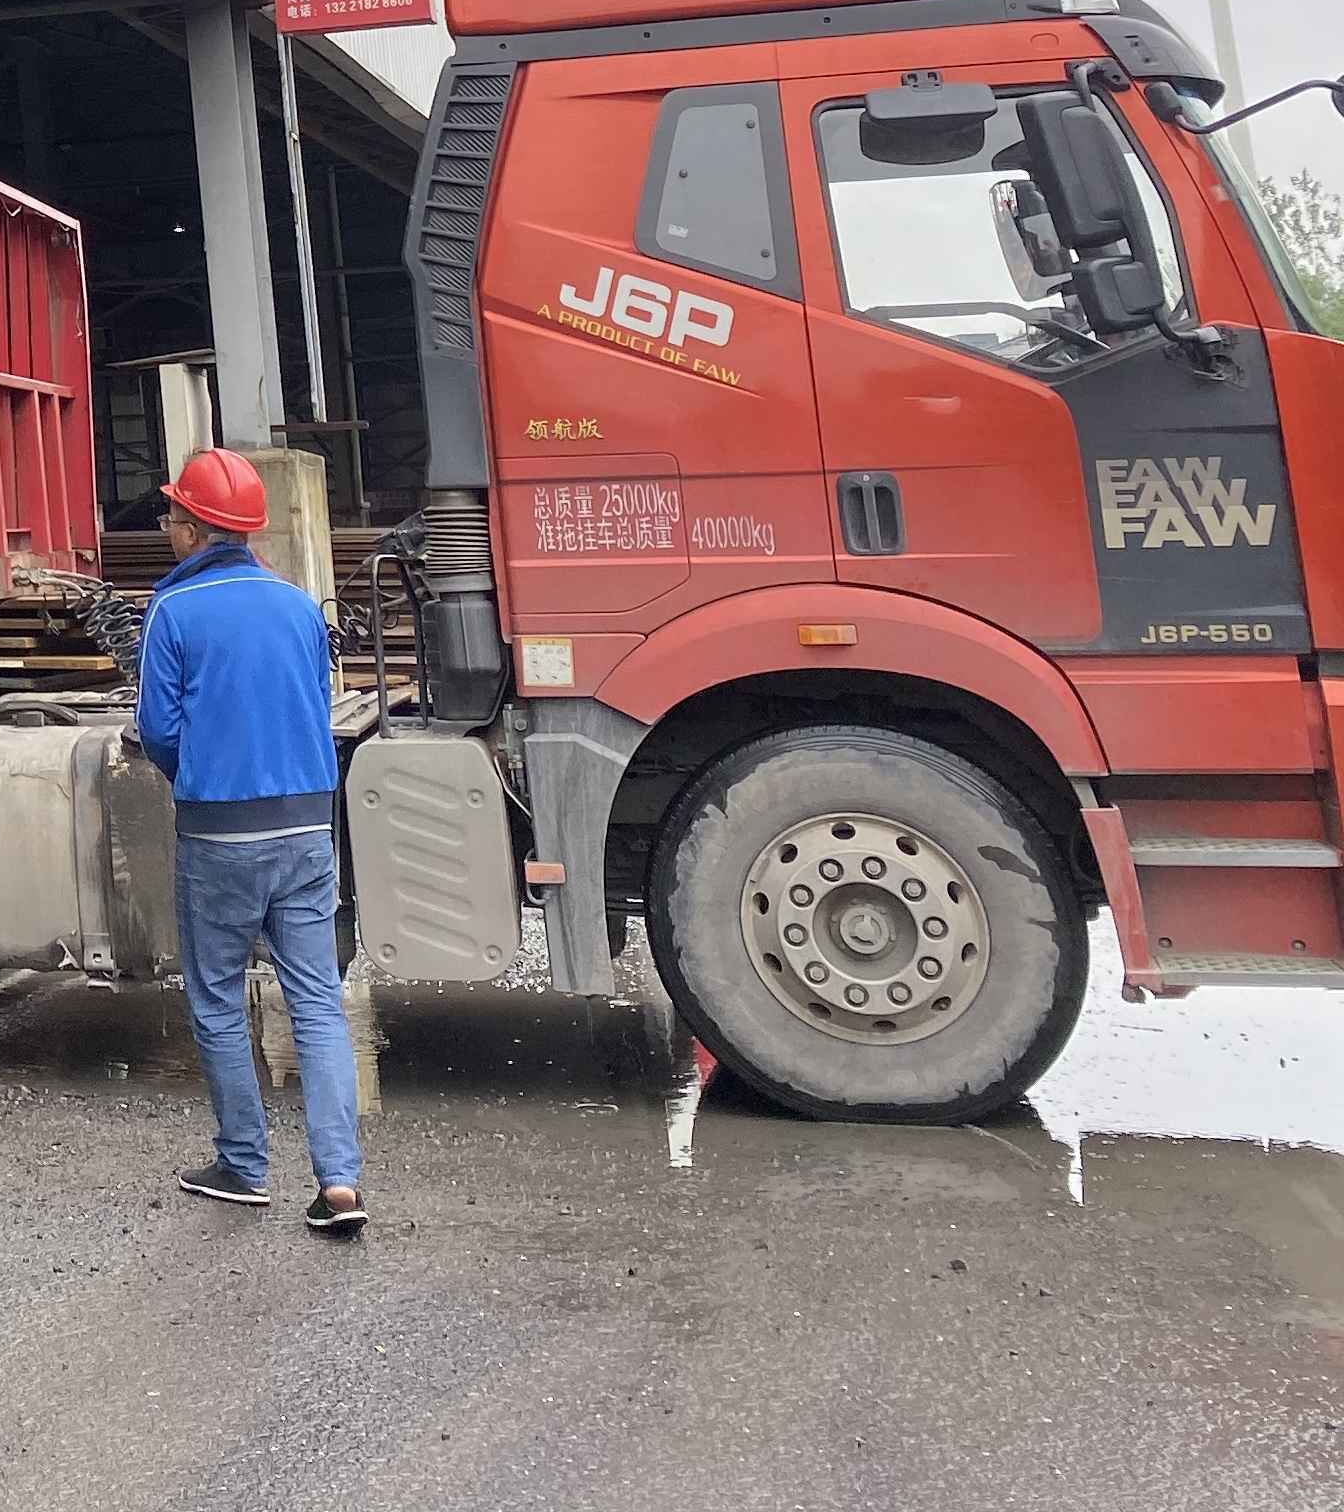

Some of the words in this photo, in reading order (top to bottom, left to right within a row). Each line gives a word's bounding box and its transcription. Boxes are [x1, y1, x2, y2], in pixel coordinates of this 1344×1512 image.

[559, 267, 734, 347] J6P
[536, 304, 552, 320] A
[558, 311, 654, 354] PRODUCT
[660, 347, 689, 365] OF
[693, 358, 741, 386] FAW
[524, 417, 605, 440] 领航版
[534, 485, 595, 519] 总质量
[599, 482, 680, 522] 25000kg
[536, 517, 674, 552] 准拖挂车总质量
[691, 516, 776, 555] 40000kg
[1104, 504, 1276, 548] FAW
[1140, 623, 1273, 644] J6P-550
